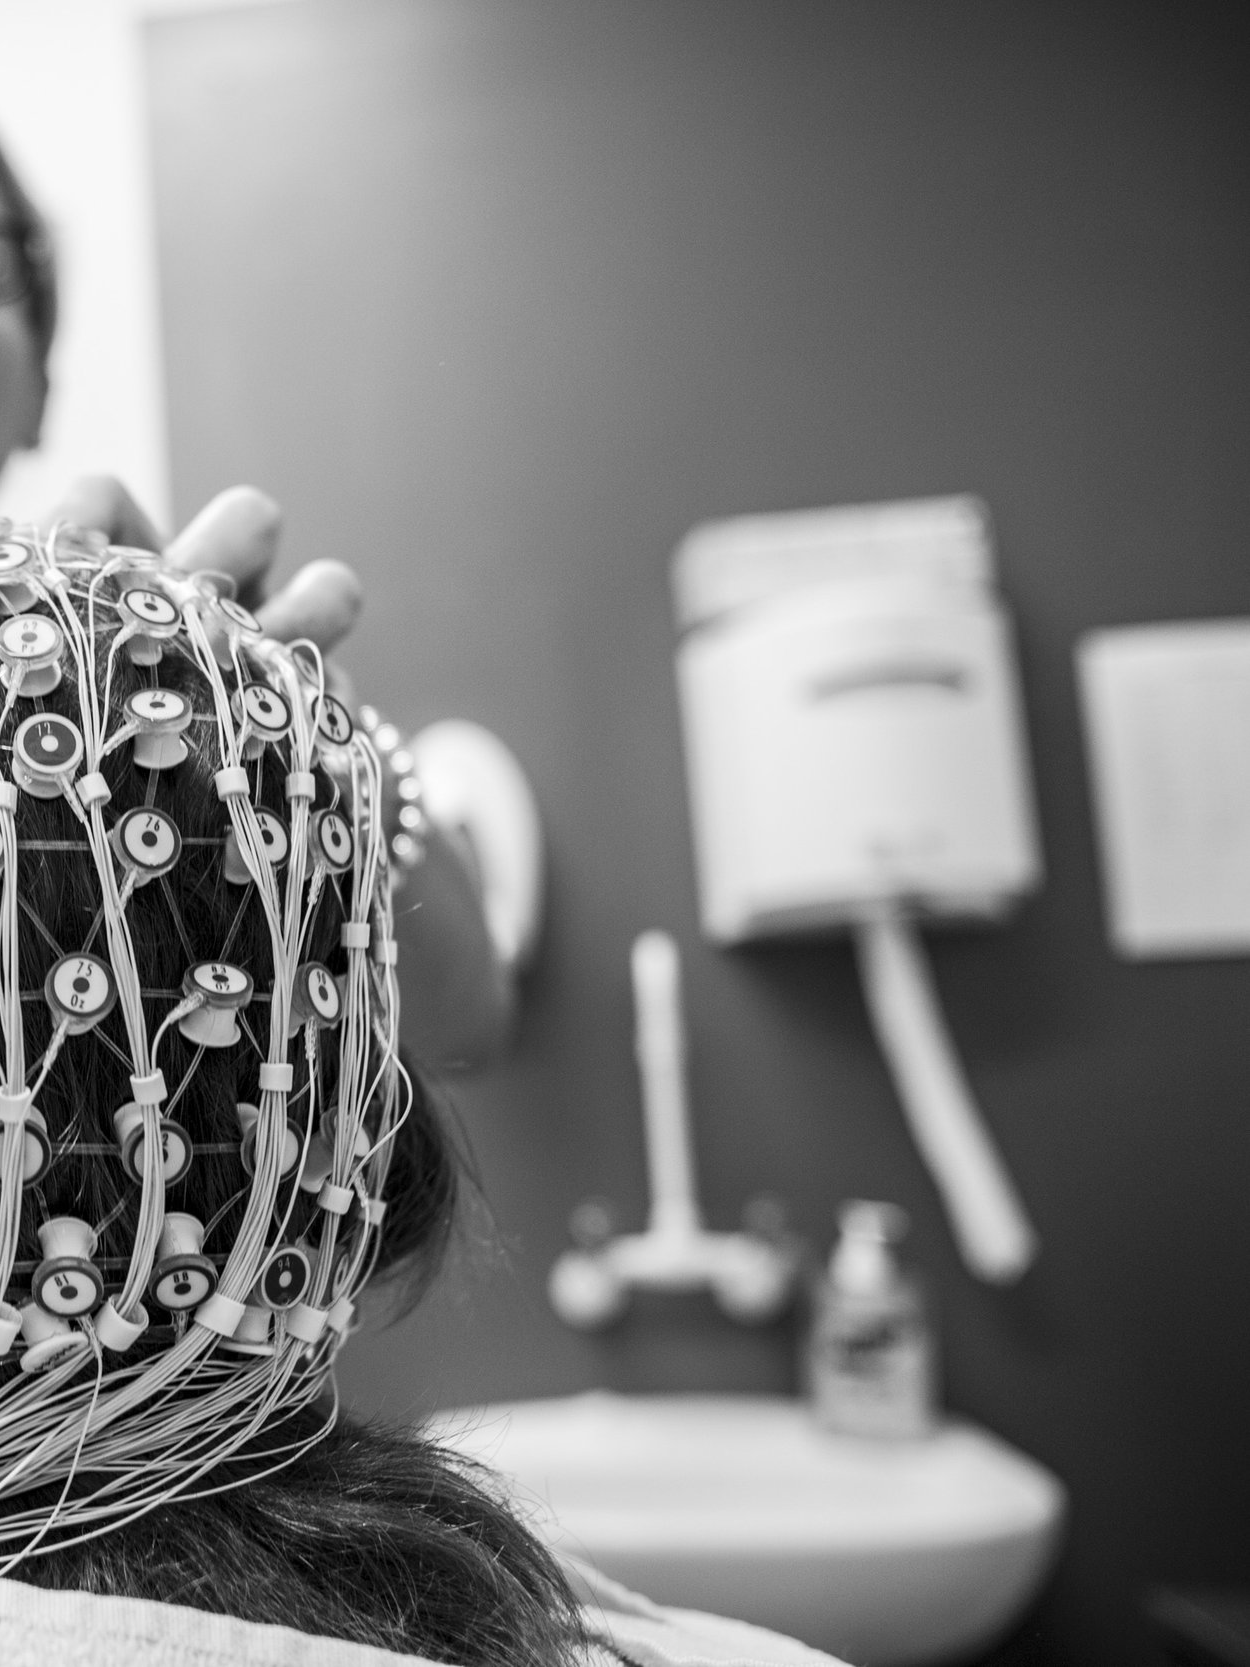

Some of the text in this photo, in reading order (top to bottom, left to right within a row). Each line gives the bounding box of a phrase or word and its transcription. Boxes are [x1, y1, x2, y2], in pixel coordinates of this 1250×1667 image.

[23, 620, 38, 630] 62
[252, 688, 265, 700] 85
[35, 721, 52, 736] 72
[146, 815, 160, 832] 76
[77, 960, 93, 977] 75
[54, 1273, 69, 1287] 81
[173, 1271, 189, 1284] 88
